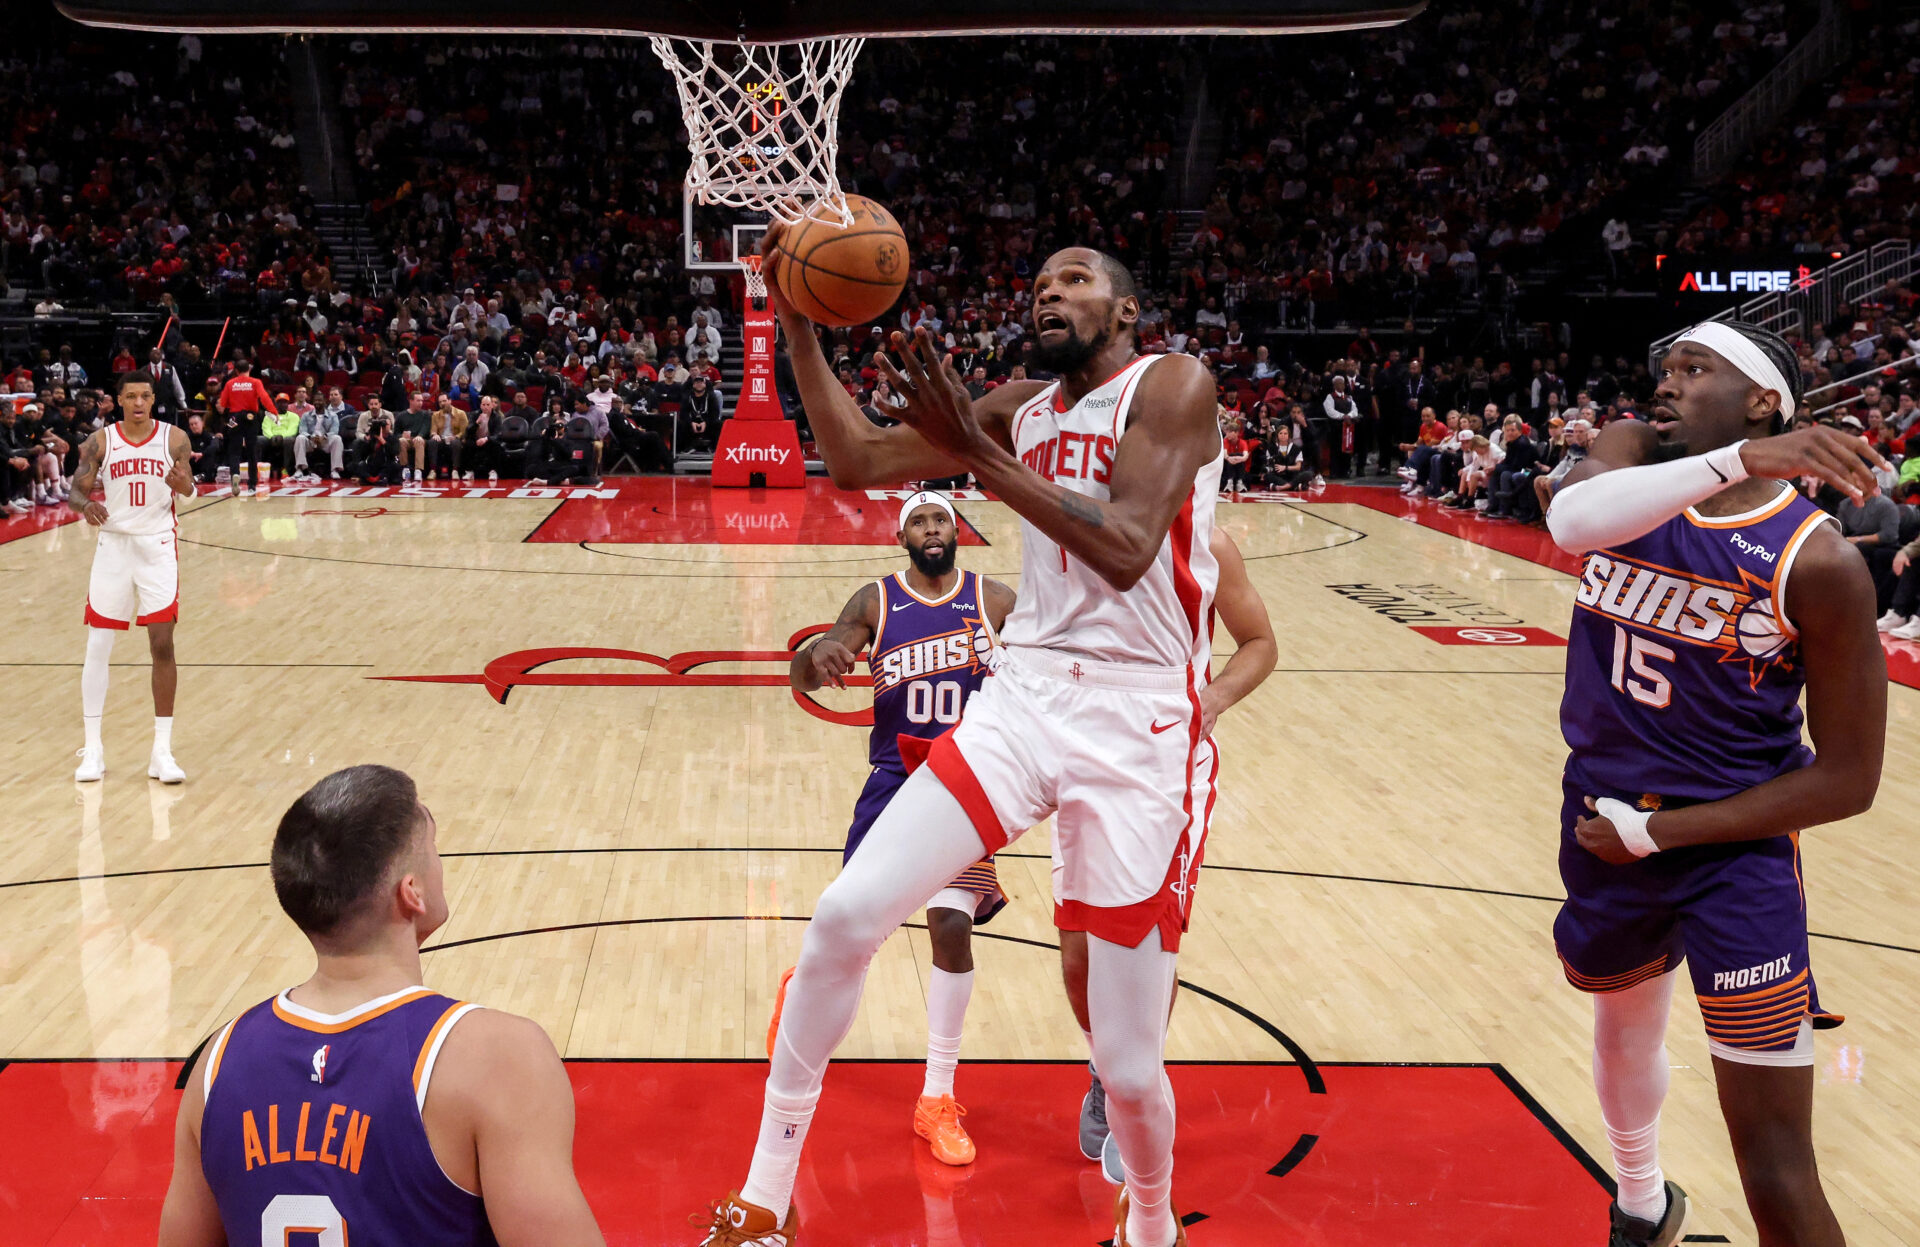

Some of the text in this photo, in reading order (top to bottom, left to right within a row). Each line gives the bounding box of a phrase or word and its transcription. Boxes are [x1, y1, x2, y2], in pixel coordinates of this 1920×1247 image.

[1679, 271, 1790, 291] ALL FIRE
[110, 458, 164, 480] ROCKETS
[725, 442, 790, 464] xfinity
[128, 481, 145, 506] 10
[1730, 533, 1776, 563] PayPal
[951, 602, 975, 611] PayPal
[1324, 583, 1451, 624] TOYOTA
[1394, 583, 1525, 625] CENTER
[1577, 554, 1736, 641] SUNS
[883, 633, 969, 687] SUNS
[1611, 623, 1676, 709] 15
[907, 680, 961, 724] 00
[1713, 953, 1792, 991] PHOENIX
[242, 1102, 371, 1175] ALLEN
